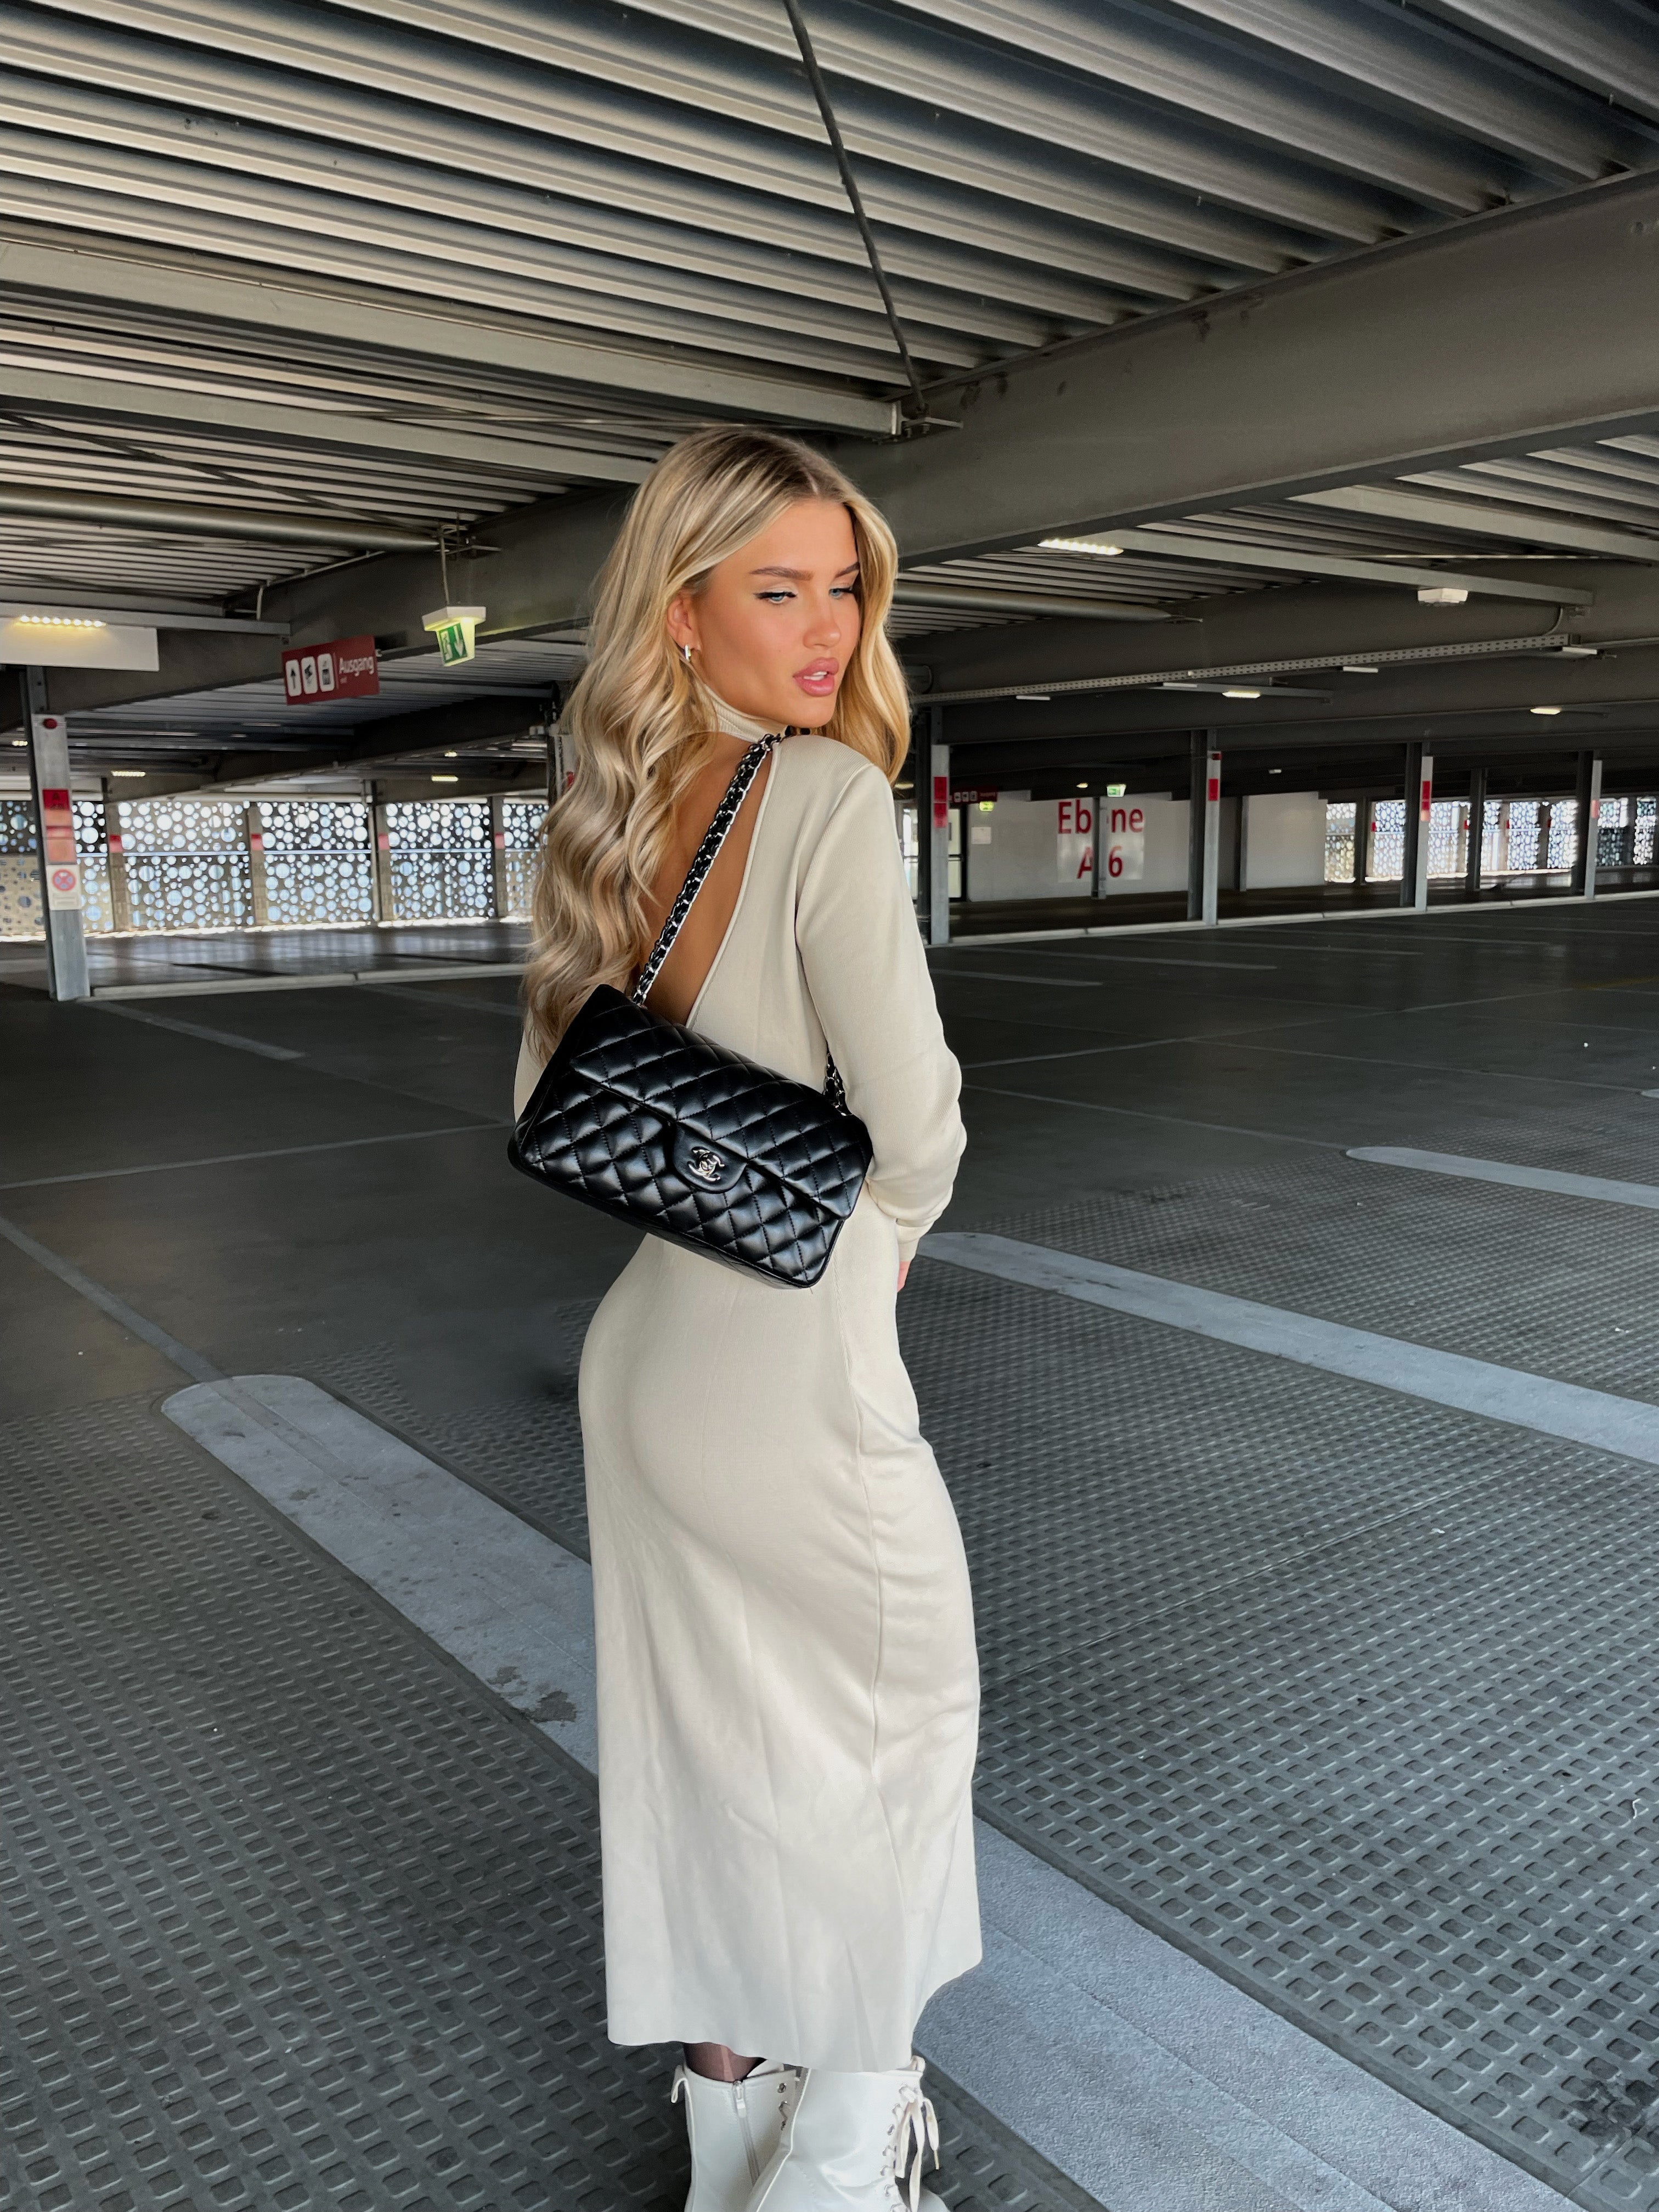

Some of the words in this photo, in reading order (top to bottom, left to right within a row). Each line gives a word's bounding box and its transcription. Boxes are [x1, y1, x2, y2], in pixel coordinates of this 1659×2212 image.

[339, 656, 374, 676] Ausgang
[1058, 799, 1144, 834] Ebne
[1108, 845, 1122, 877] 6
